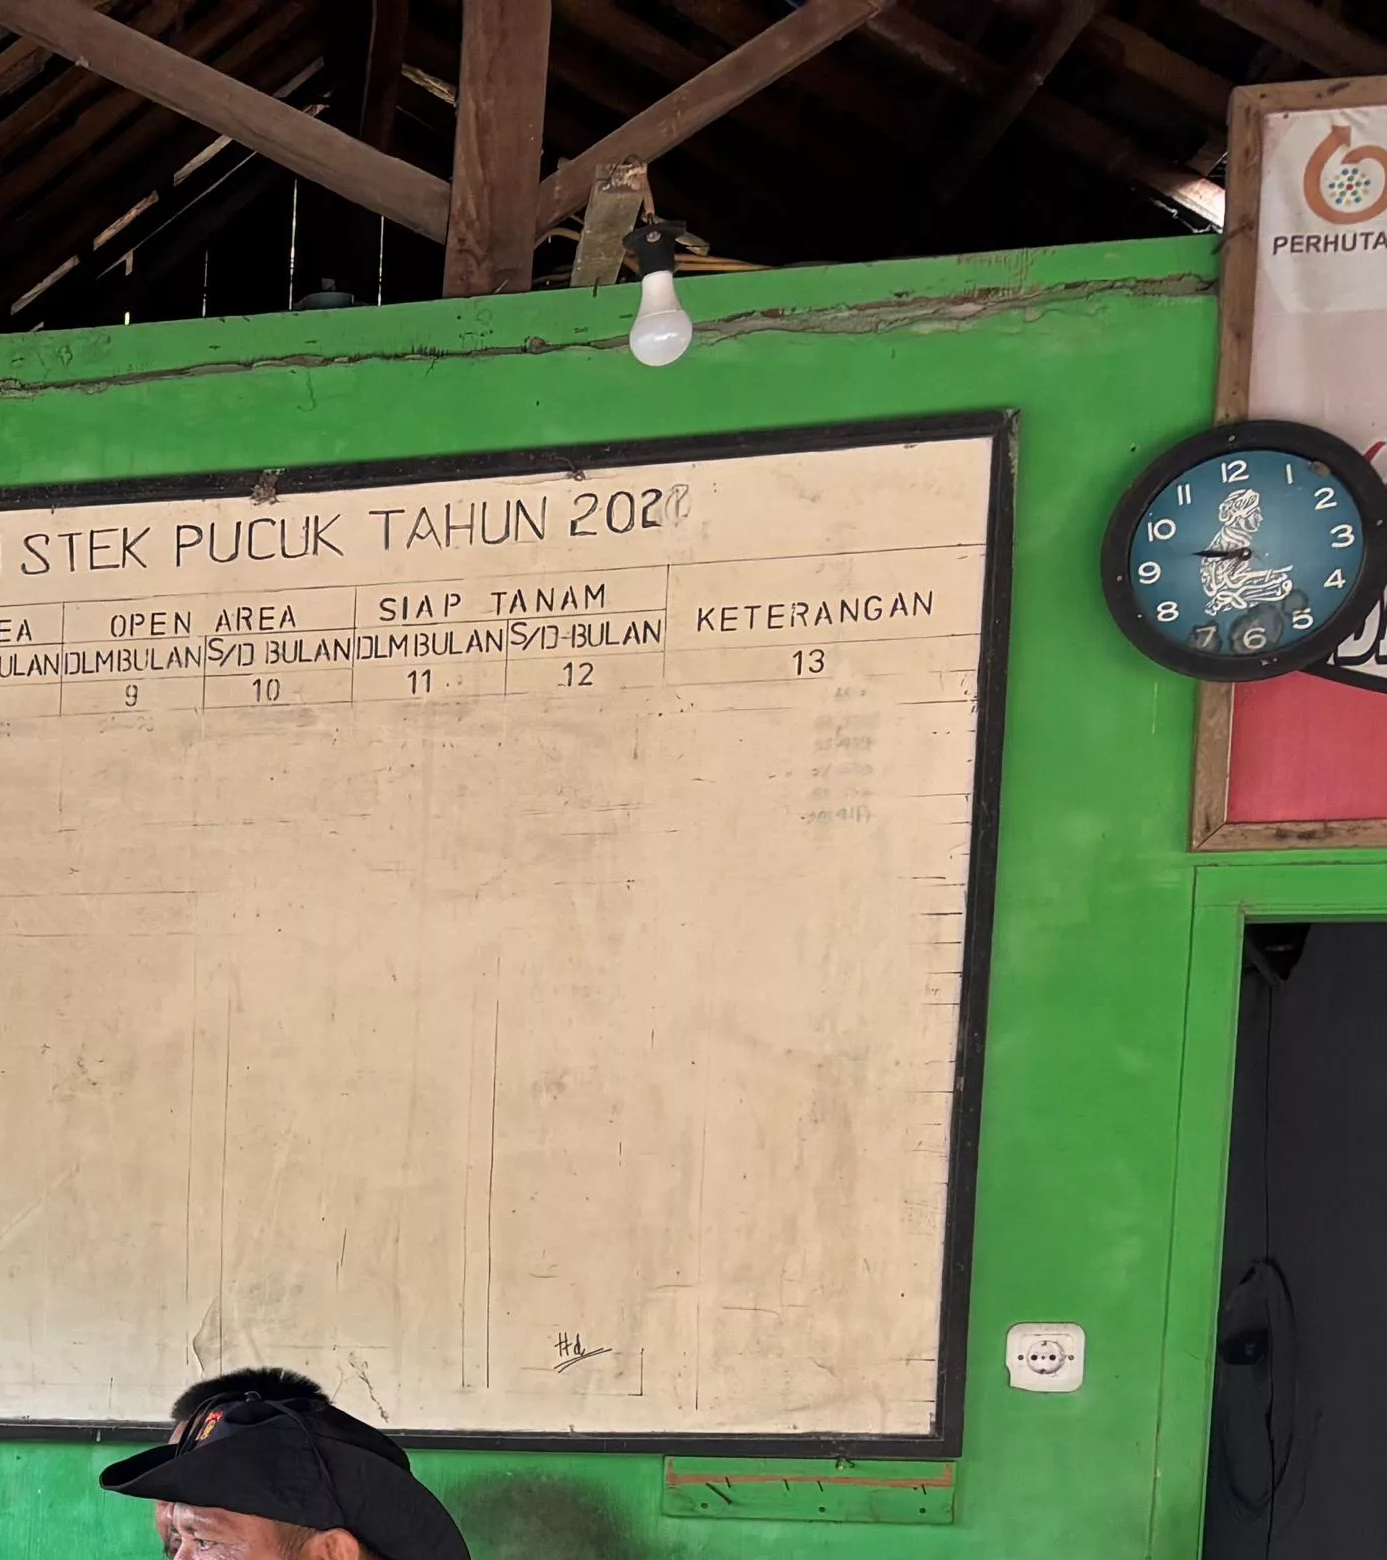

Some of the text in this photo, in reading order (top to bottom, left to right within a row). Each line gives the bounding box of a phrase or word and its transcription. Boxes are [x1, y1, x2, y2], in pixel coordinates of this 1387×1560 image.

[1221, 460, 1249, 483] 12
[1286, 464, 1293, 484] 1
[1178, 484, 1191, 505] 11
[1314, 487, 1337, 510] 2
[21, 525, 152, 577] STEK
[175, 513, 345, 567] PUCUK
[369, 496, 546, 550] TAHUN
[1147, 519, 1176, 542] 10
[1330, 525, 1355, 548] 3
[1138, 561, 1161, 585] 9
[1324, 569, 1346, 589] 4
[379, 584, 605, 621] SIAP TANAM
[697, 590, 933, 634] KETERANGAN
[1157, 601, 1179, 622] 8
[110, 605, 296, 637] OPEN AREA
[1292, 608, 1314, 629] 5
[1198, 626, 1216, 647] 7
[1243, 627, 1266, 649] 6
[265, 637, 351, 664] BULAN
[792, 649, 825, 676] 13
[407, 669, 431, 694] 11
[563, 662, 594, 688] 12
[125, 684, 138, 707] 9
[252, 678, 280, 702] 10
